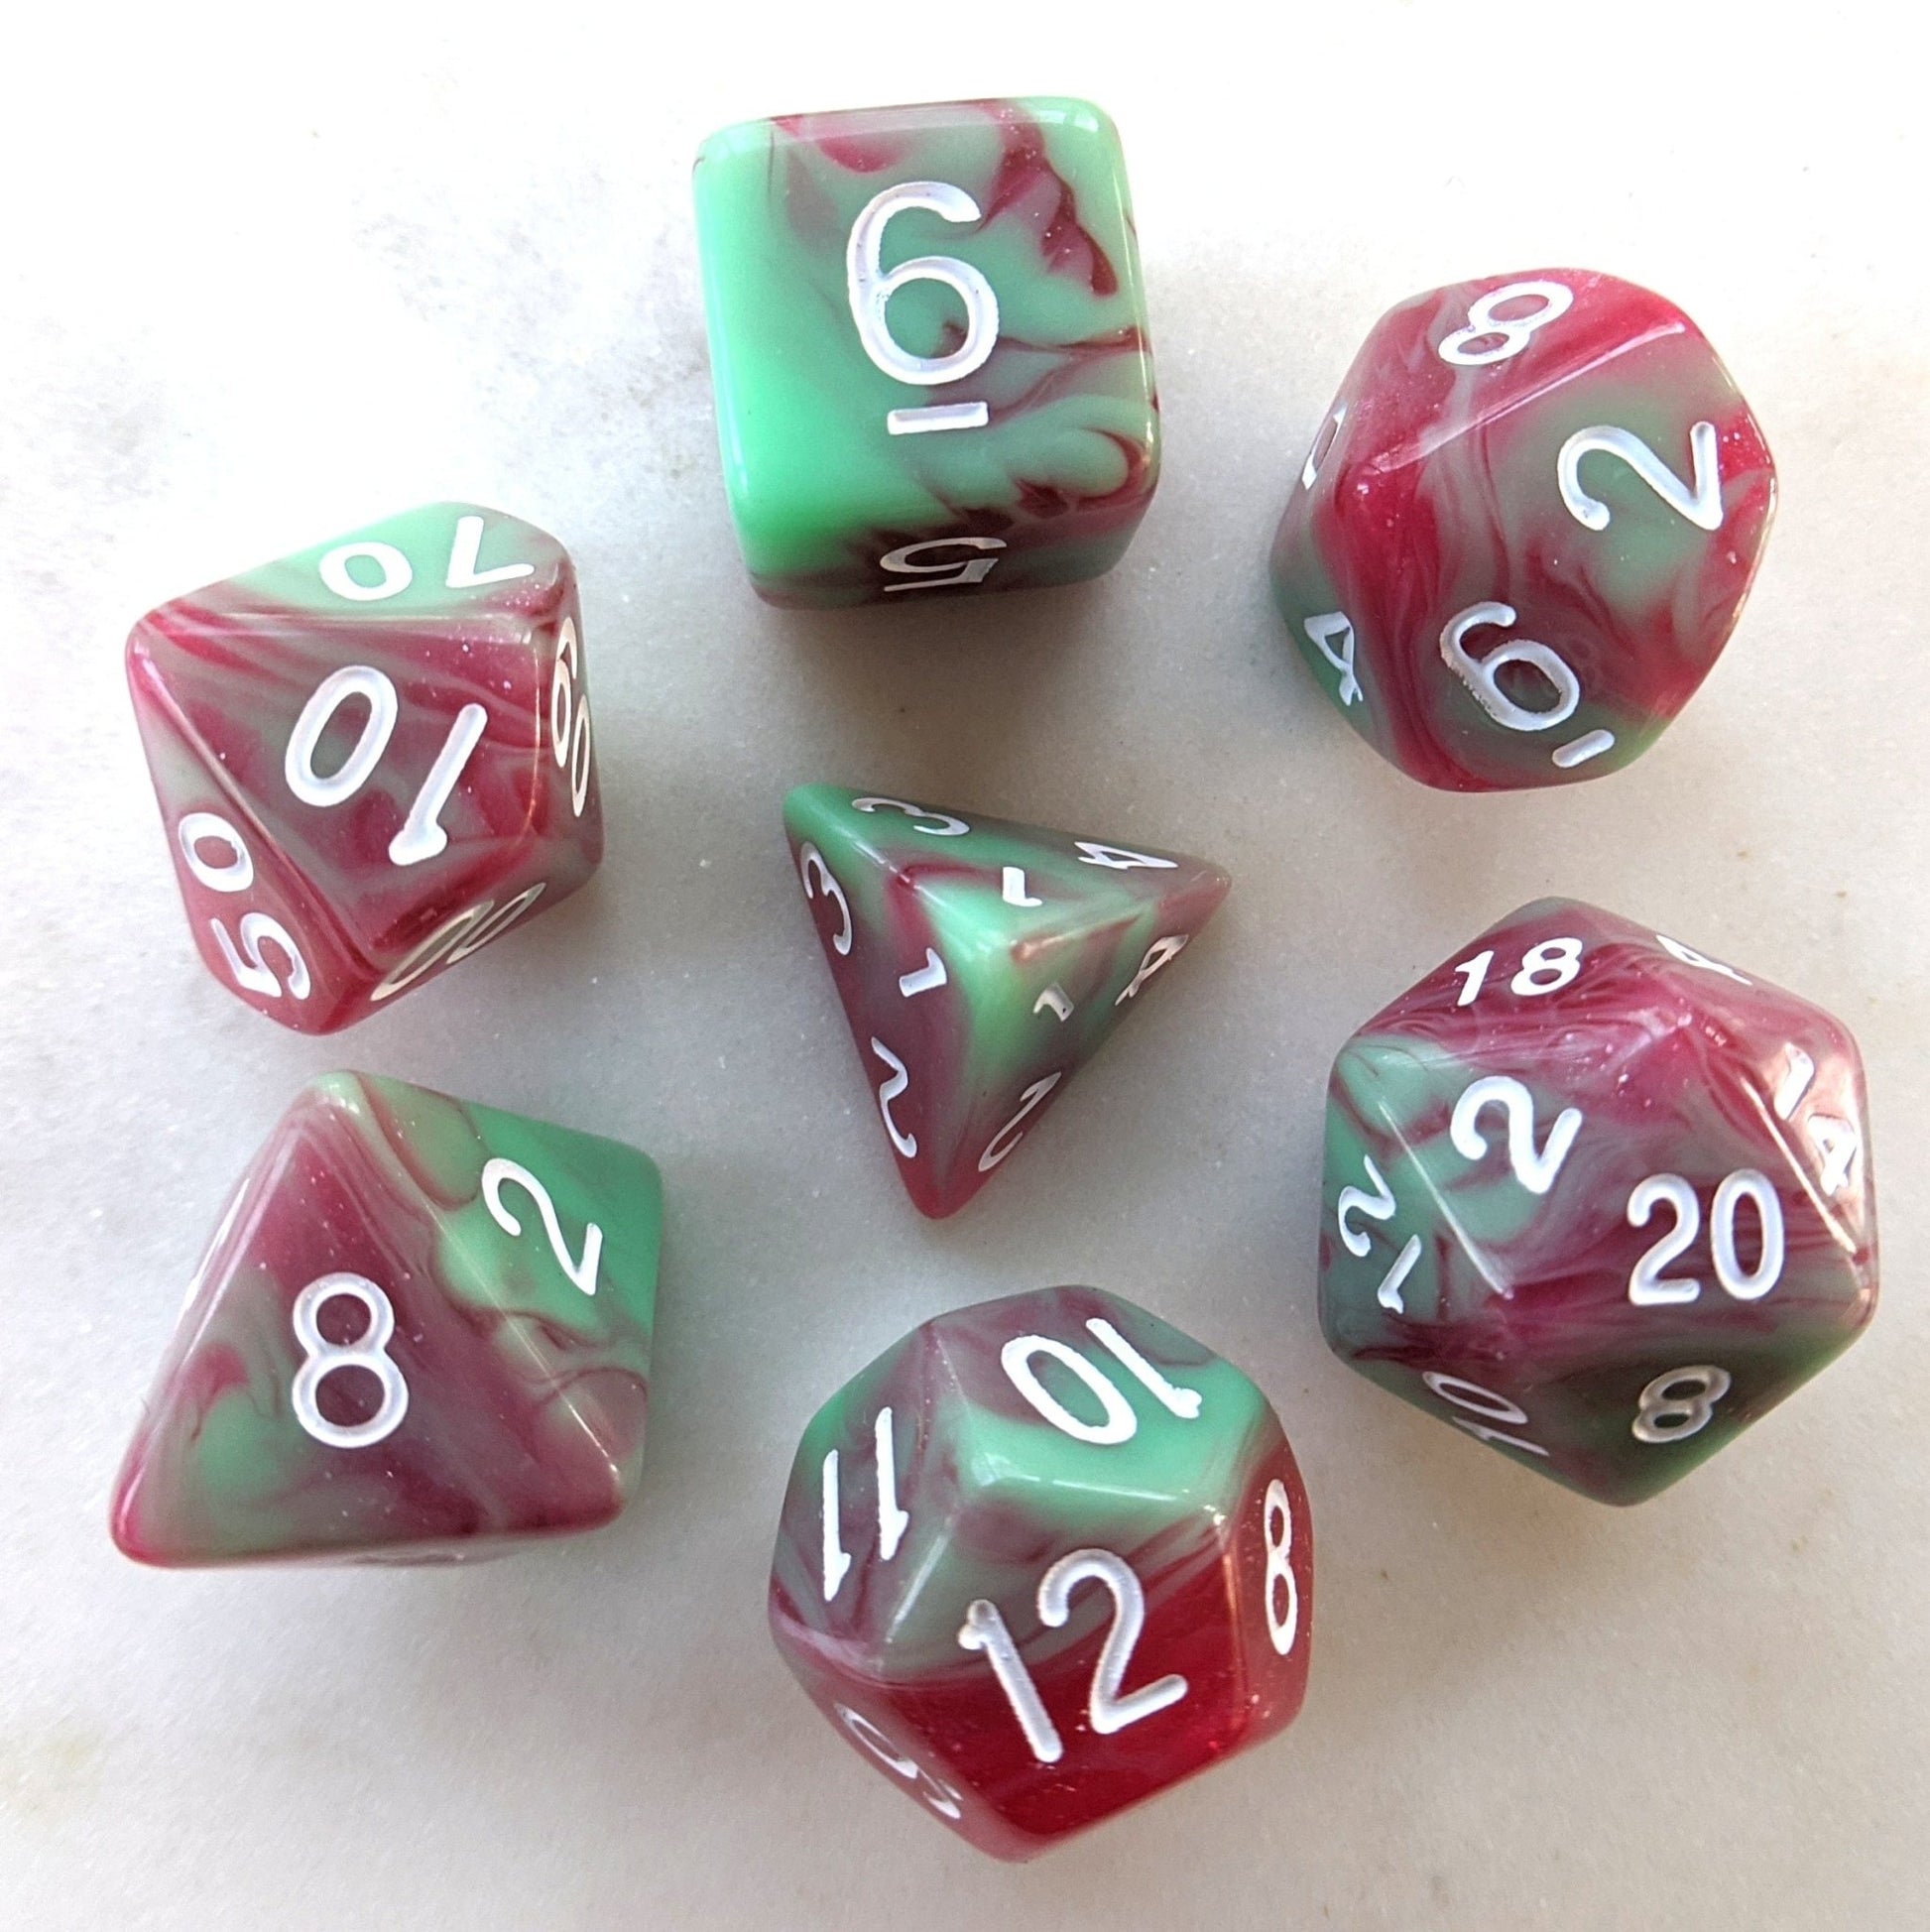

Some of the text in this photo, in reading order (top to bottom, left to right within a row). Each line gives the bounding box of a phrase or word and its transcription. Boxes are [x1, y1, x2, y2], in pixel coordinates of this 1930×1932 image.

[846, 181, 1000, 386] 6
[1438, 281, 1574, 366] 8
[1557, 422, 1724, 531] 2
[319, 516, 535, 601] 70
[880, 537, 1008, 592] 5
[1303, 611, 1364, 706] 4
[284, 665, 488, 866] 10
[852, 796, 970, 836] 3
[800, 841, 853, 956] 3
[1003, 866, 1043, 907] 1
[1074, 841, 1178, 869] 4
[899, 947, 948, 998] 1
[1032, 981, 1075, 1023] 1
[1115, 934, 1189, 1006] 4
[1455, 937, 1584, 1007] 18
[871, 1036, 917, 1158] 2
[978, 1071, 1062, 1172] 2
[1450, 1075, 1584, 1195] 2
[1773, 1042, 1858, 1196] 14
[481, 1157, 604, 1296] 2
[1337, 1153, 1422, 1314] 12
[1627, 1168, 1785, 1306] 20
[293, 1272, 410, 1449] 8
[1001, 1317, 1203, 1445] 10
[1422, 1371, 1549, 1457] 10
[1631, 1365, 1732, 1444] 8
[821, 1406, 909, 1602] 11
[1264, 1479, 1299, 1656] 8
[958, 1548, 1190, 1764] 12
